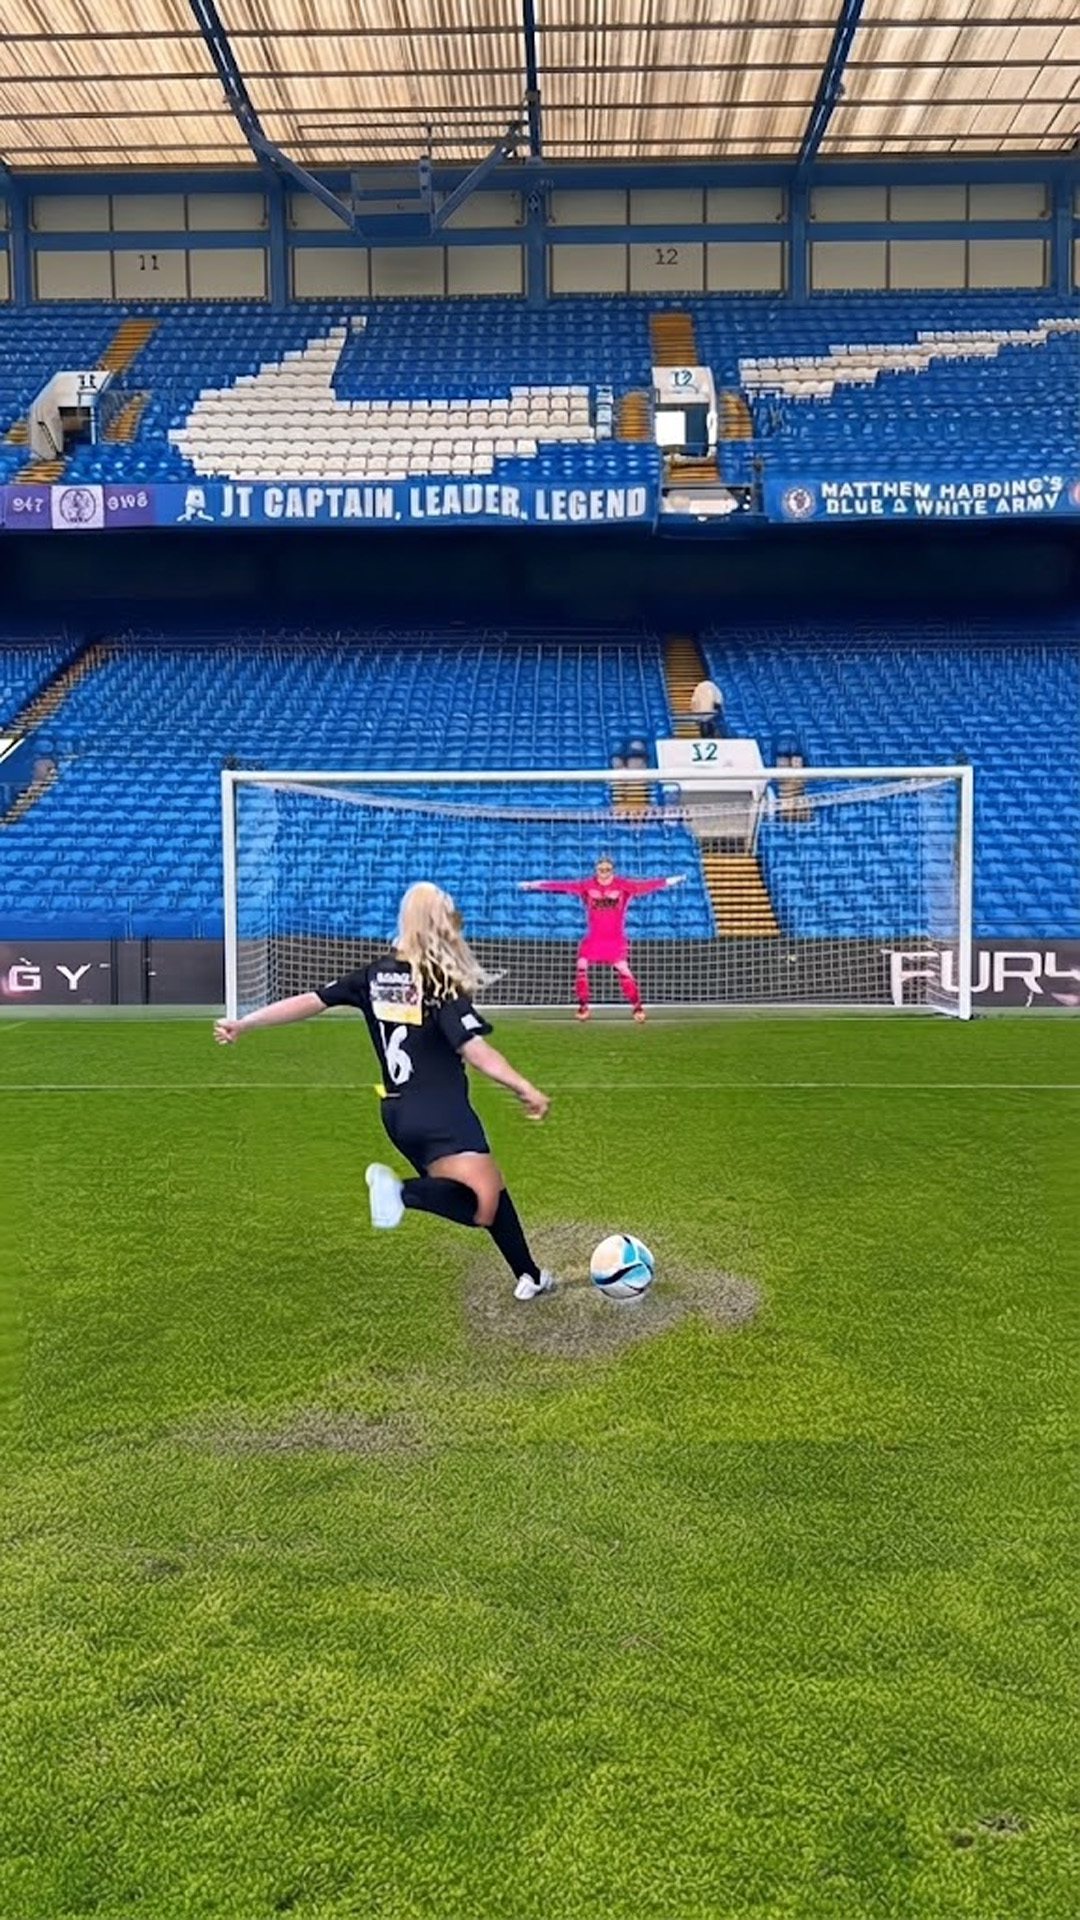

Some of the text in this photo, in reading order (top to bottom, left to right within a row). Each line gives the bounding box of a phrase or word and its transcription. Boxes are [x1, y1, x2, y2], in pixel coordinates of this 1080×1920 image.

[138, 254, 161, 271] 11
[655, 247, 679, 266] 12
[220, 483, 647, 521] JT CAPTAIN, LEADER, LEGEND
[915, 498, 988, 516] WHITE
[995, 492, 1060, 514] ARMY
[691, 742, 718, 762] 12
